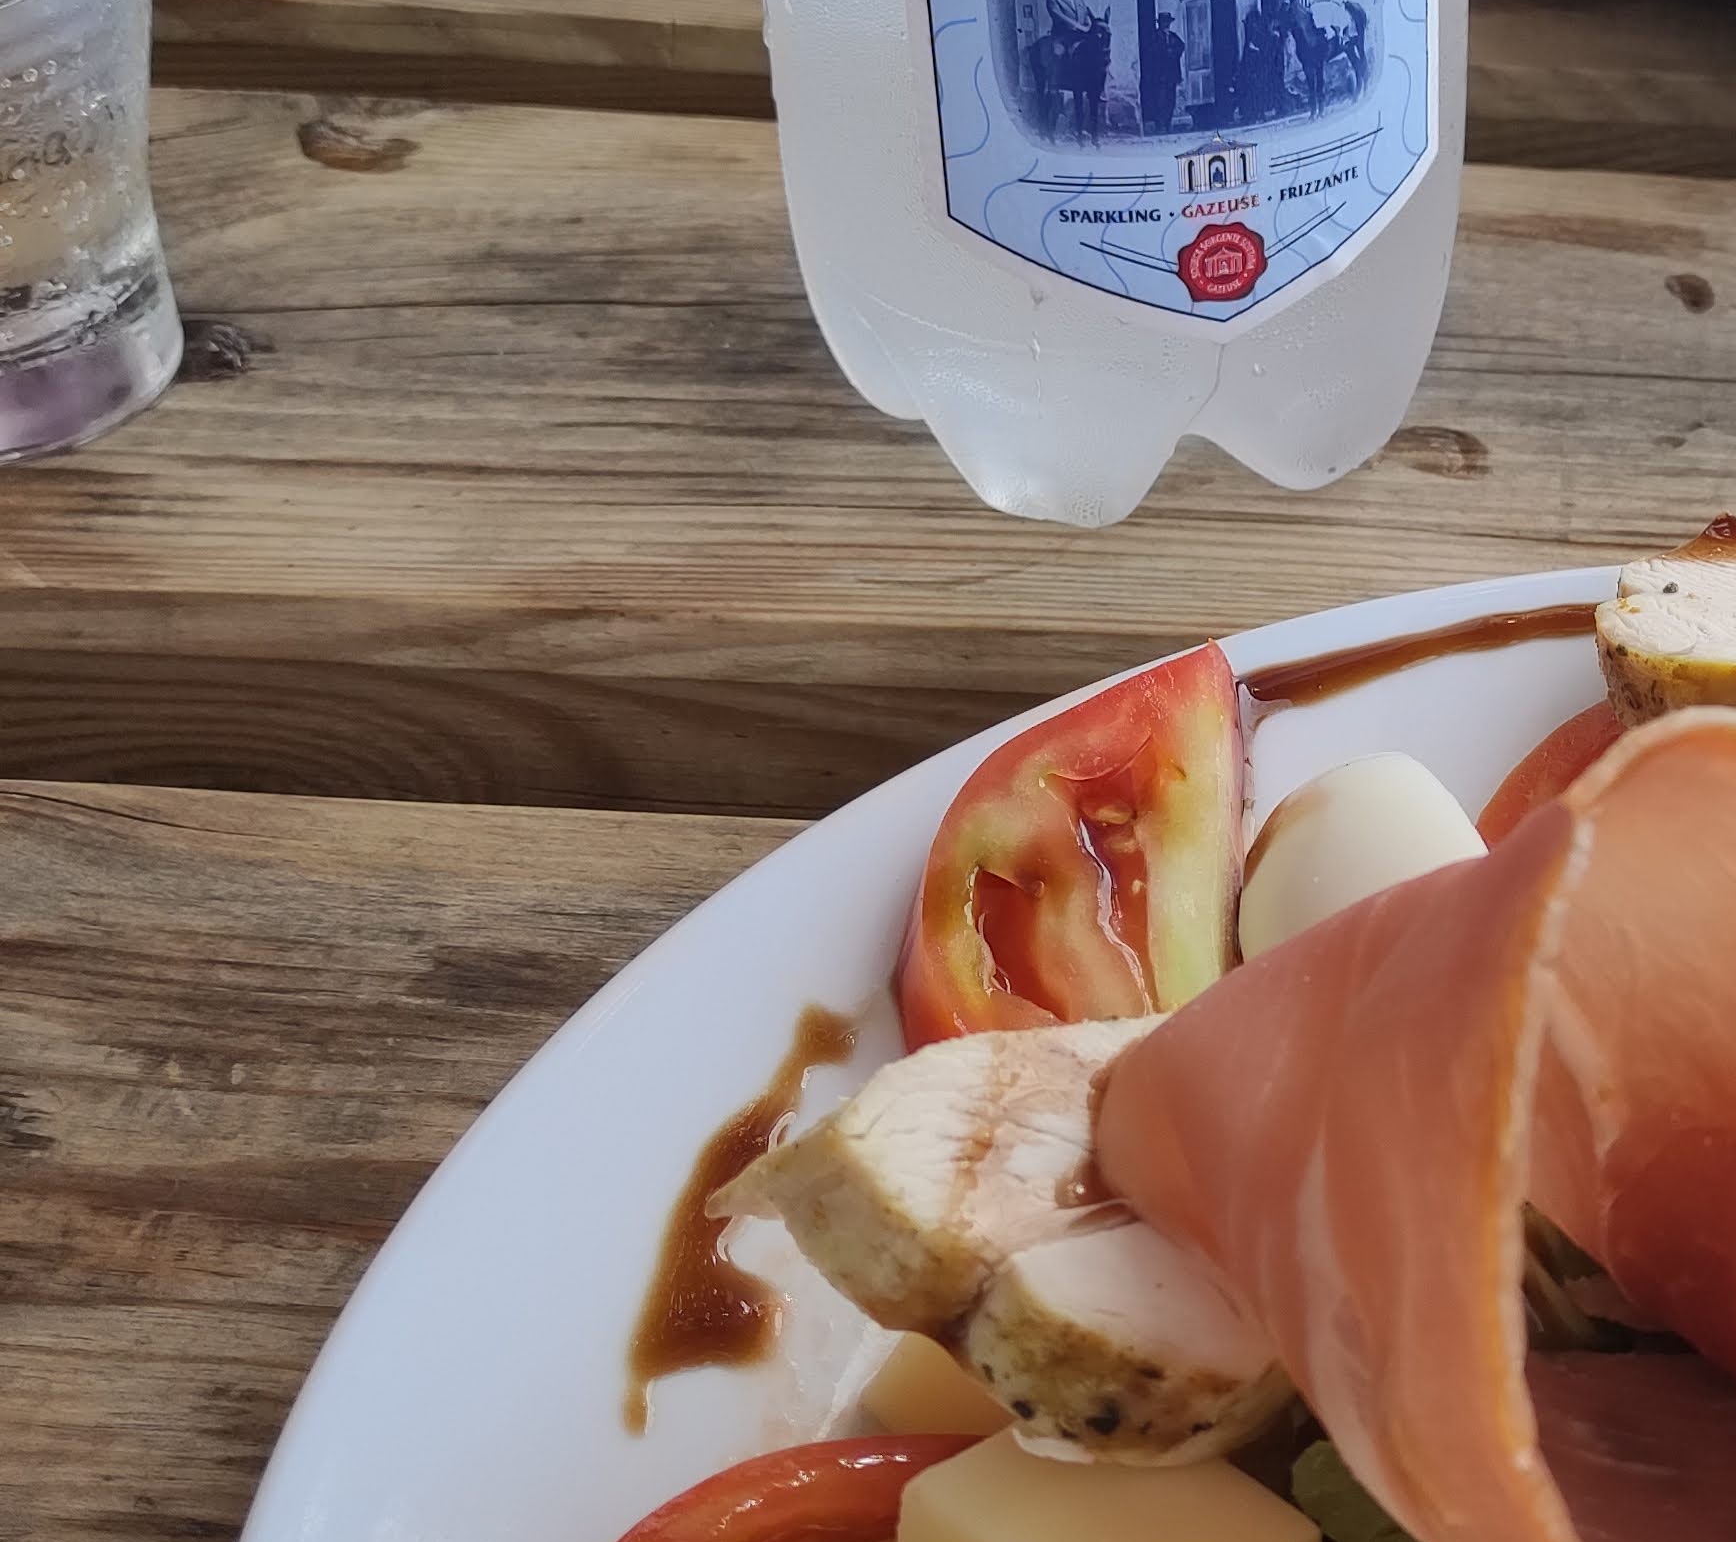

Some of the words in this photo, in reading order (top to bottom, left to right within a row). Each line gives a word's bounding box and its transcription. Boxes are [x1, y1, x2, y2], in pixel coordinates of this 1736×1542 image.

[1059, 209, 1161, 224] SPARKLING
[1181, 194, 1260, 219] GAZEUSE
[1279, 166, 1359, 202] FRIZZANTE
